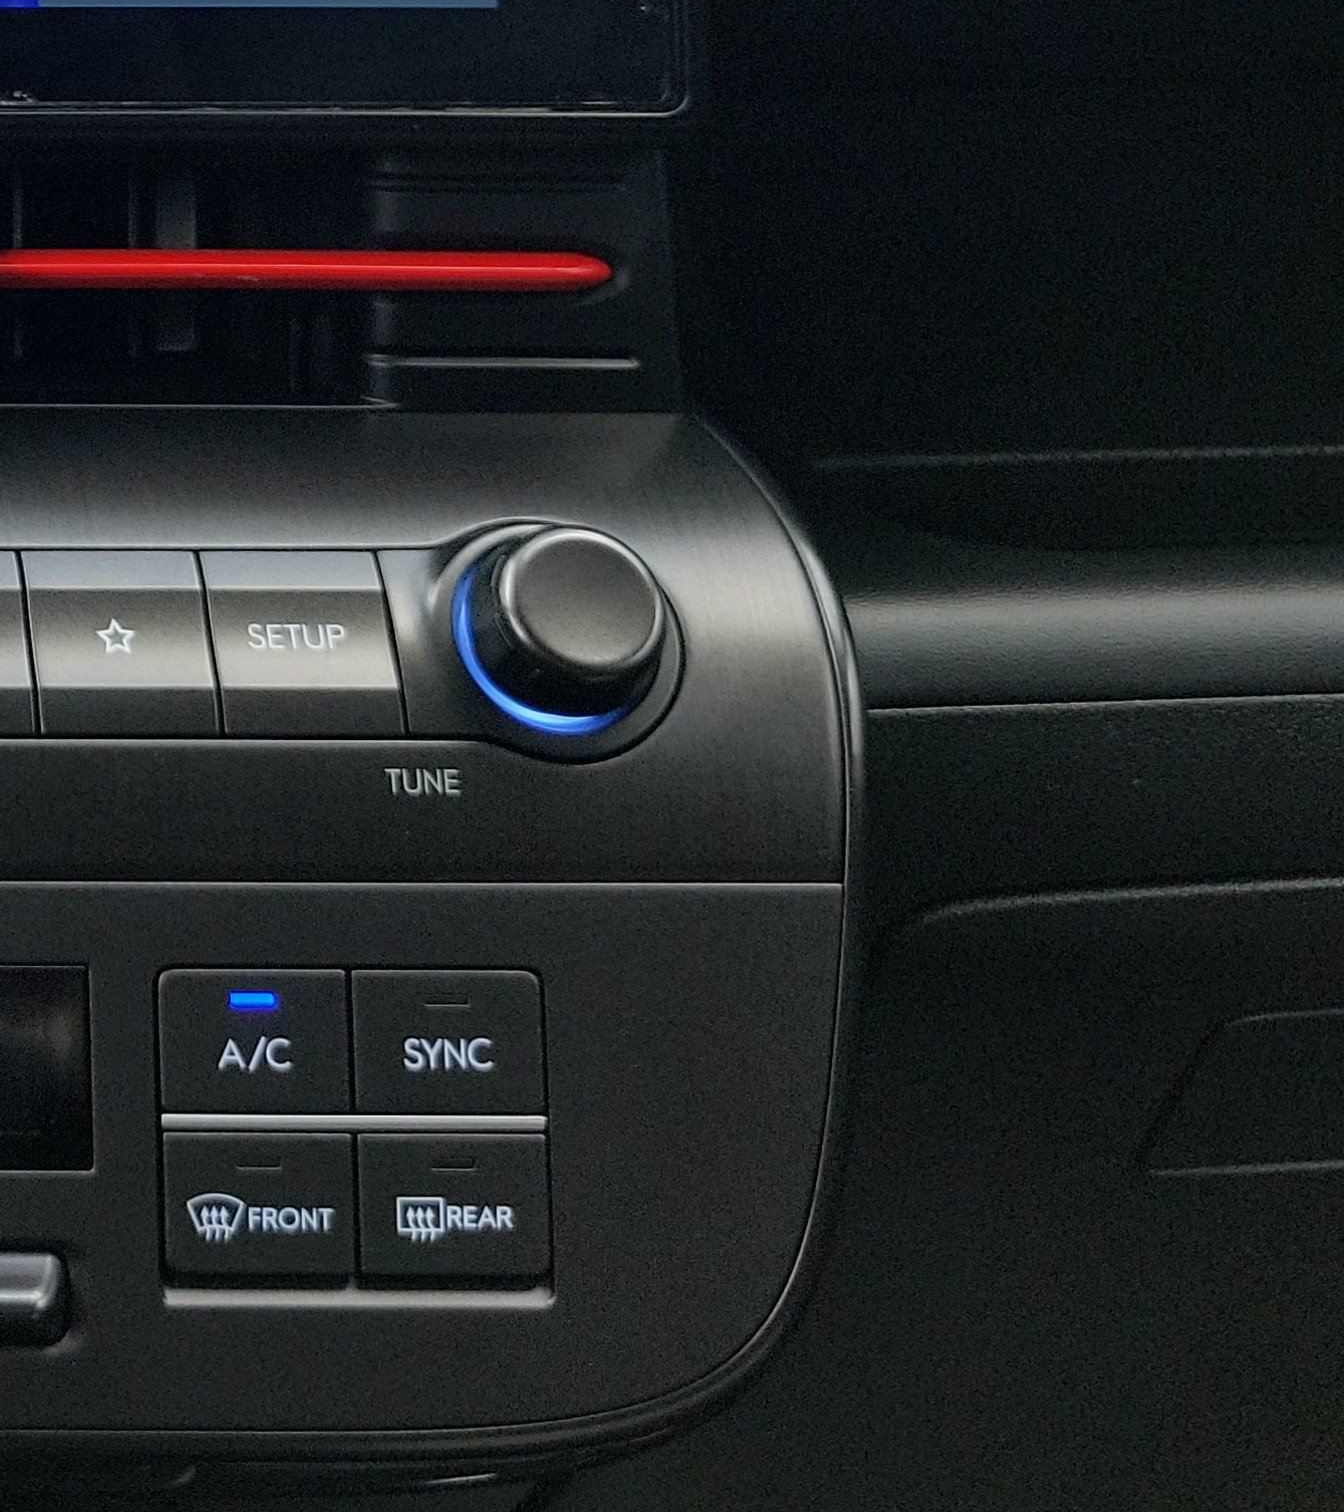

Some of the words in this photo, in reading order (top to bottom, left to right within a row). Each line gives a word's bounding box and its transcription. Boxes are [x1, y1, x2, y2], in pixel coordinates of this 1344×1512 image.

[246, 623, 349, 651] SETUP
[384, 768, 462, 797] TUNE
[218, 1036, 294, 1071] A/C
[403, 1038, 495, 1072] SYNC
[247, 1207, 335, 1232] FRONT
[446, 1205, 514, 1229] REAR
